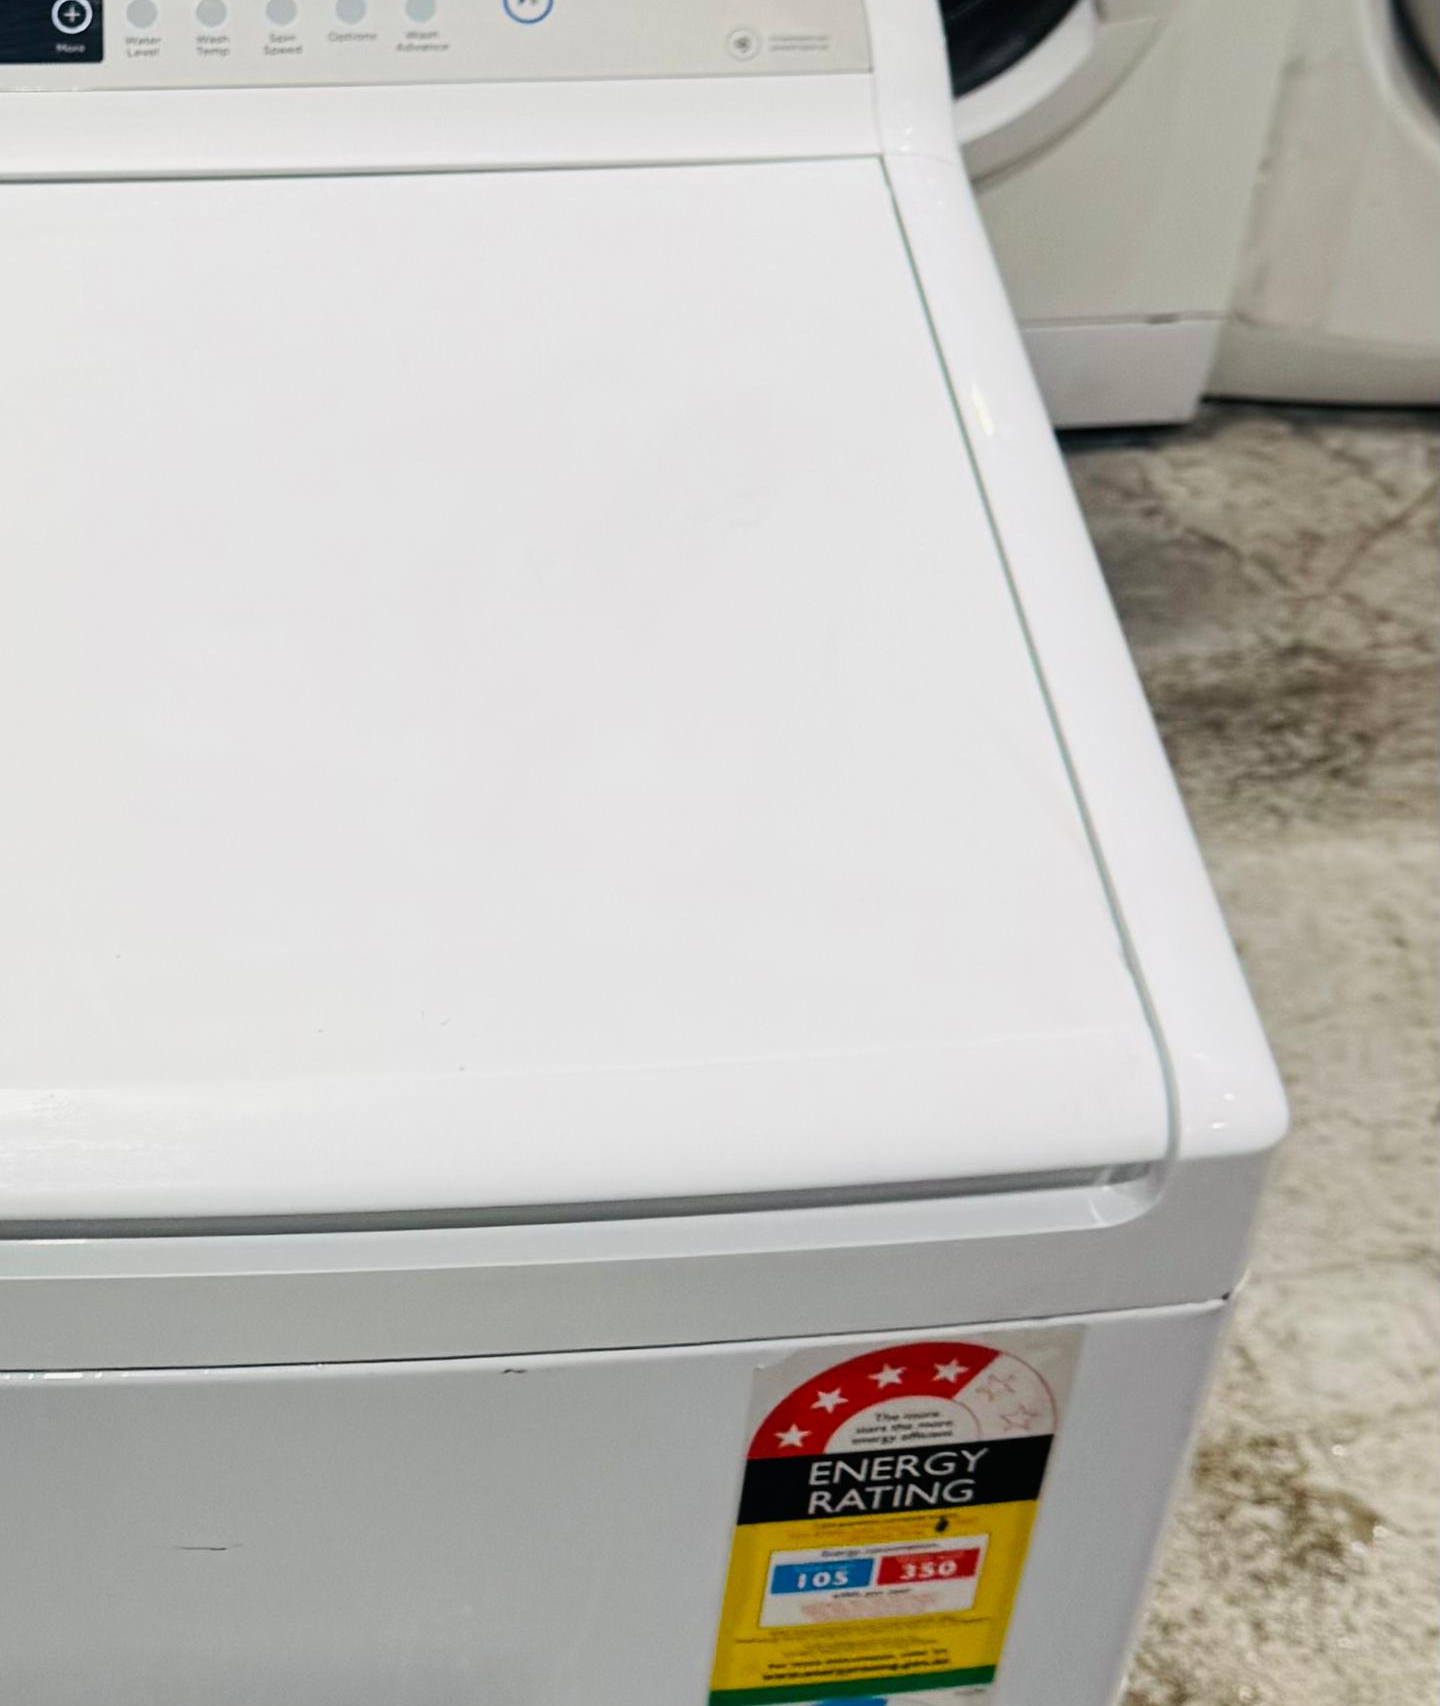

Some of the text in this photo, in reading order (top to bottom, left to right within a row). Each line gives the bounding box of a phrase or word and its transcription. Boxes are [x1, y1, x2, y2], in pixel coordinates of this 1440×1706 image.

[808, 1447, 989, 1486] ENERGY
[807, 1478, 976, 1515] RATING
[797, 1569, 849, 1590] 105
